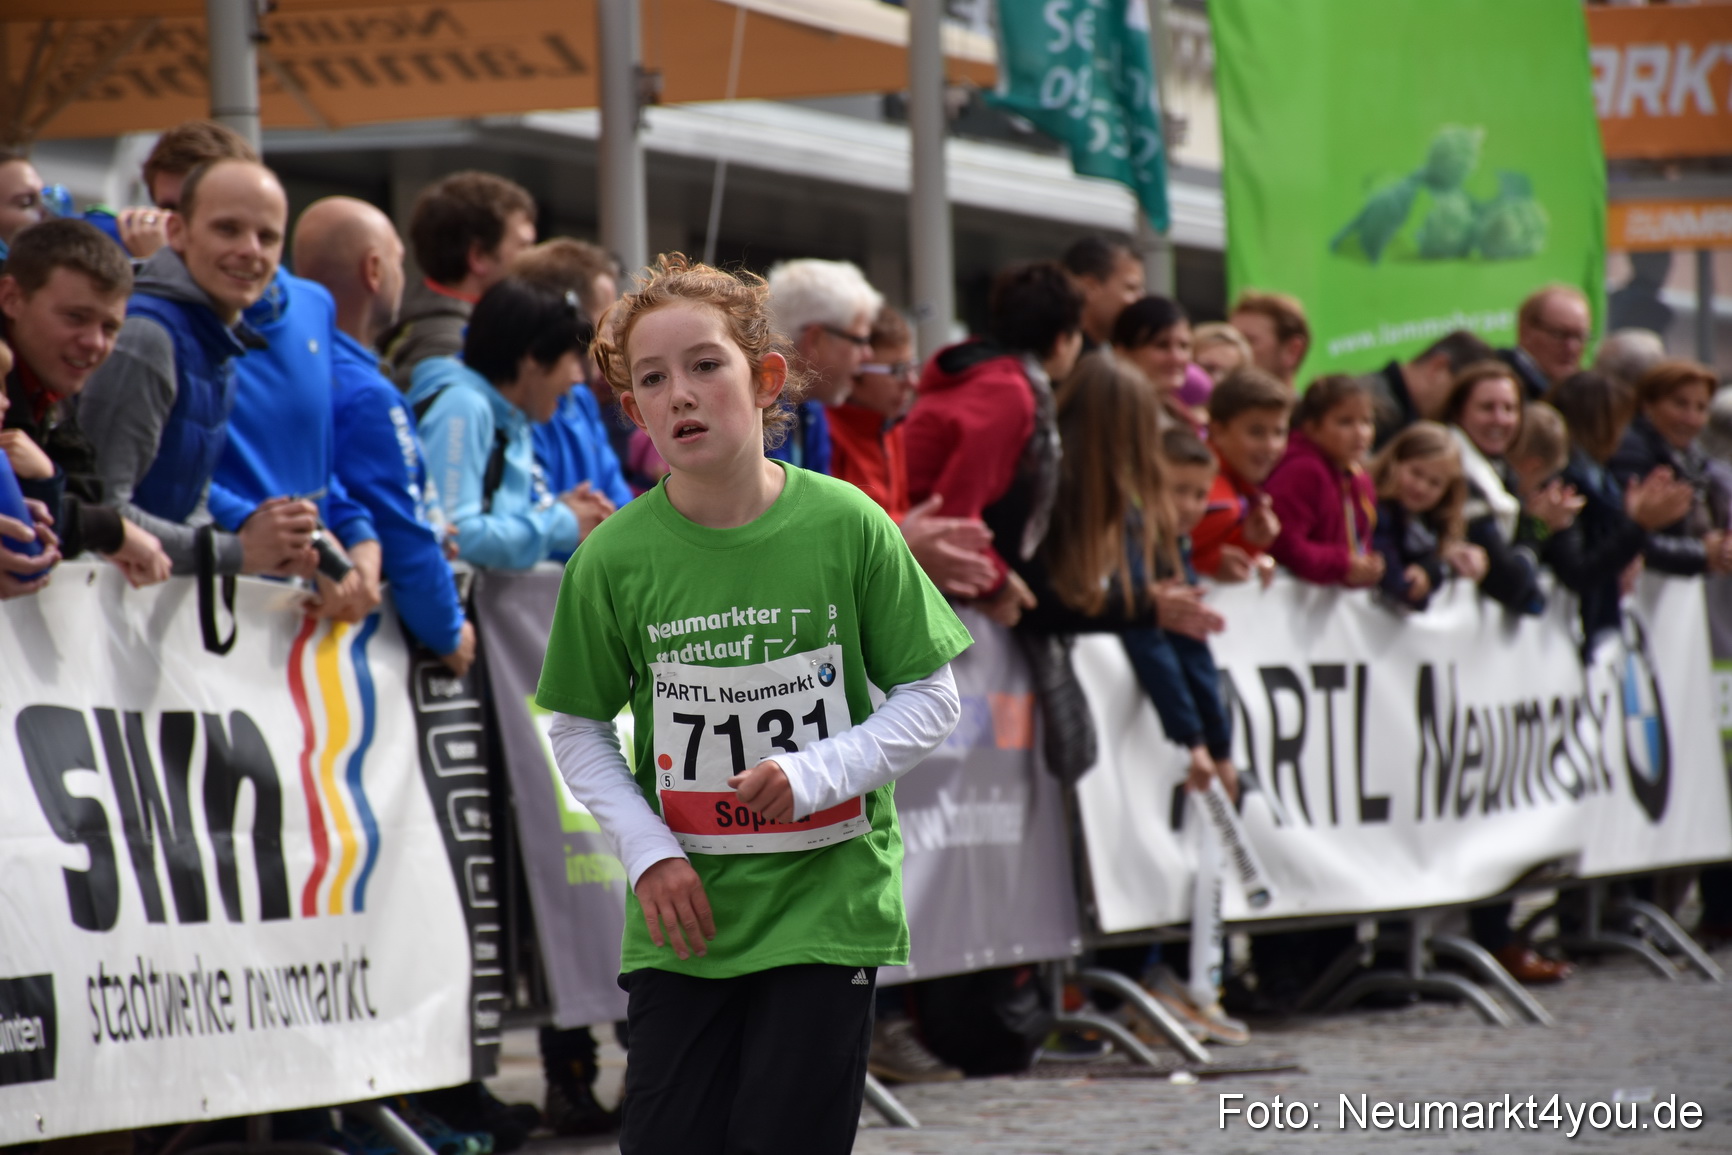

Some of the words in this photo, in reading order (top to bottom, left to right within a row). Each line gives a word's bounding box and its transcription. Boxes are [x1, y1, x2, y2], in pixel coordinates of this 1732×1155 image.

[1590, 42, 1732, 118] ARK
[647, 607, 781, 643] Neumarkter
[656, 681, 716, 703] PARTL
[719, 674, 815, 704] Neumarkt
[673, 698, 829, 781] 7131
[1171, 664, 1390, 831] ARTL
[665, 776, 671, 787] 5
[88, 954, 236, 1044] stadtwerke
[245, 943, 377, 1031] neumarkt
